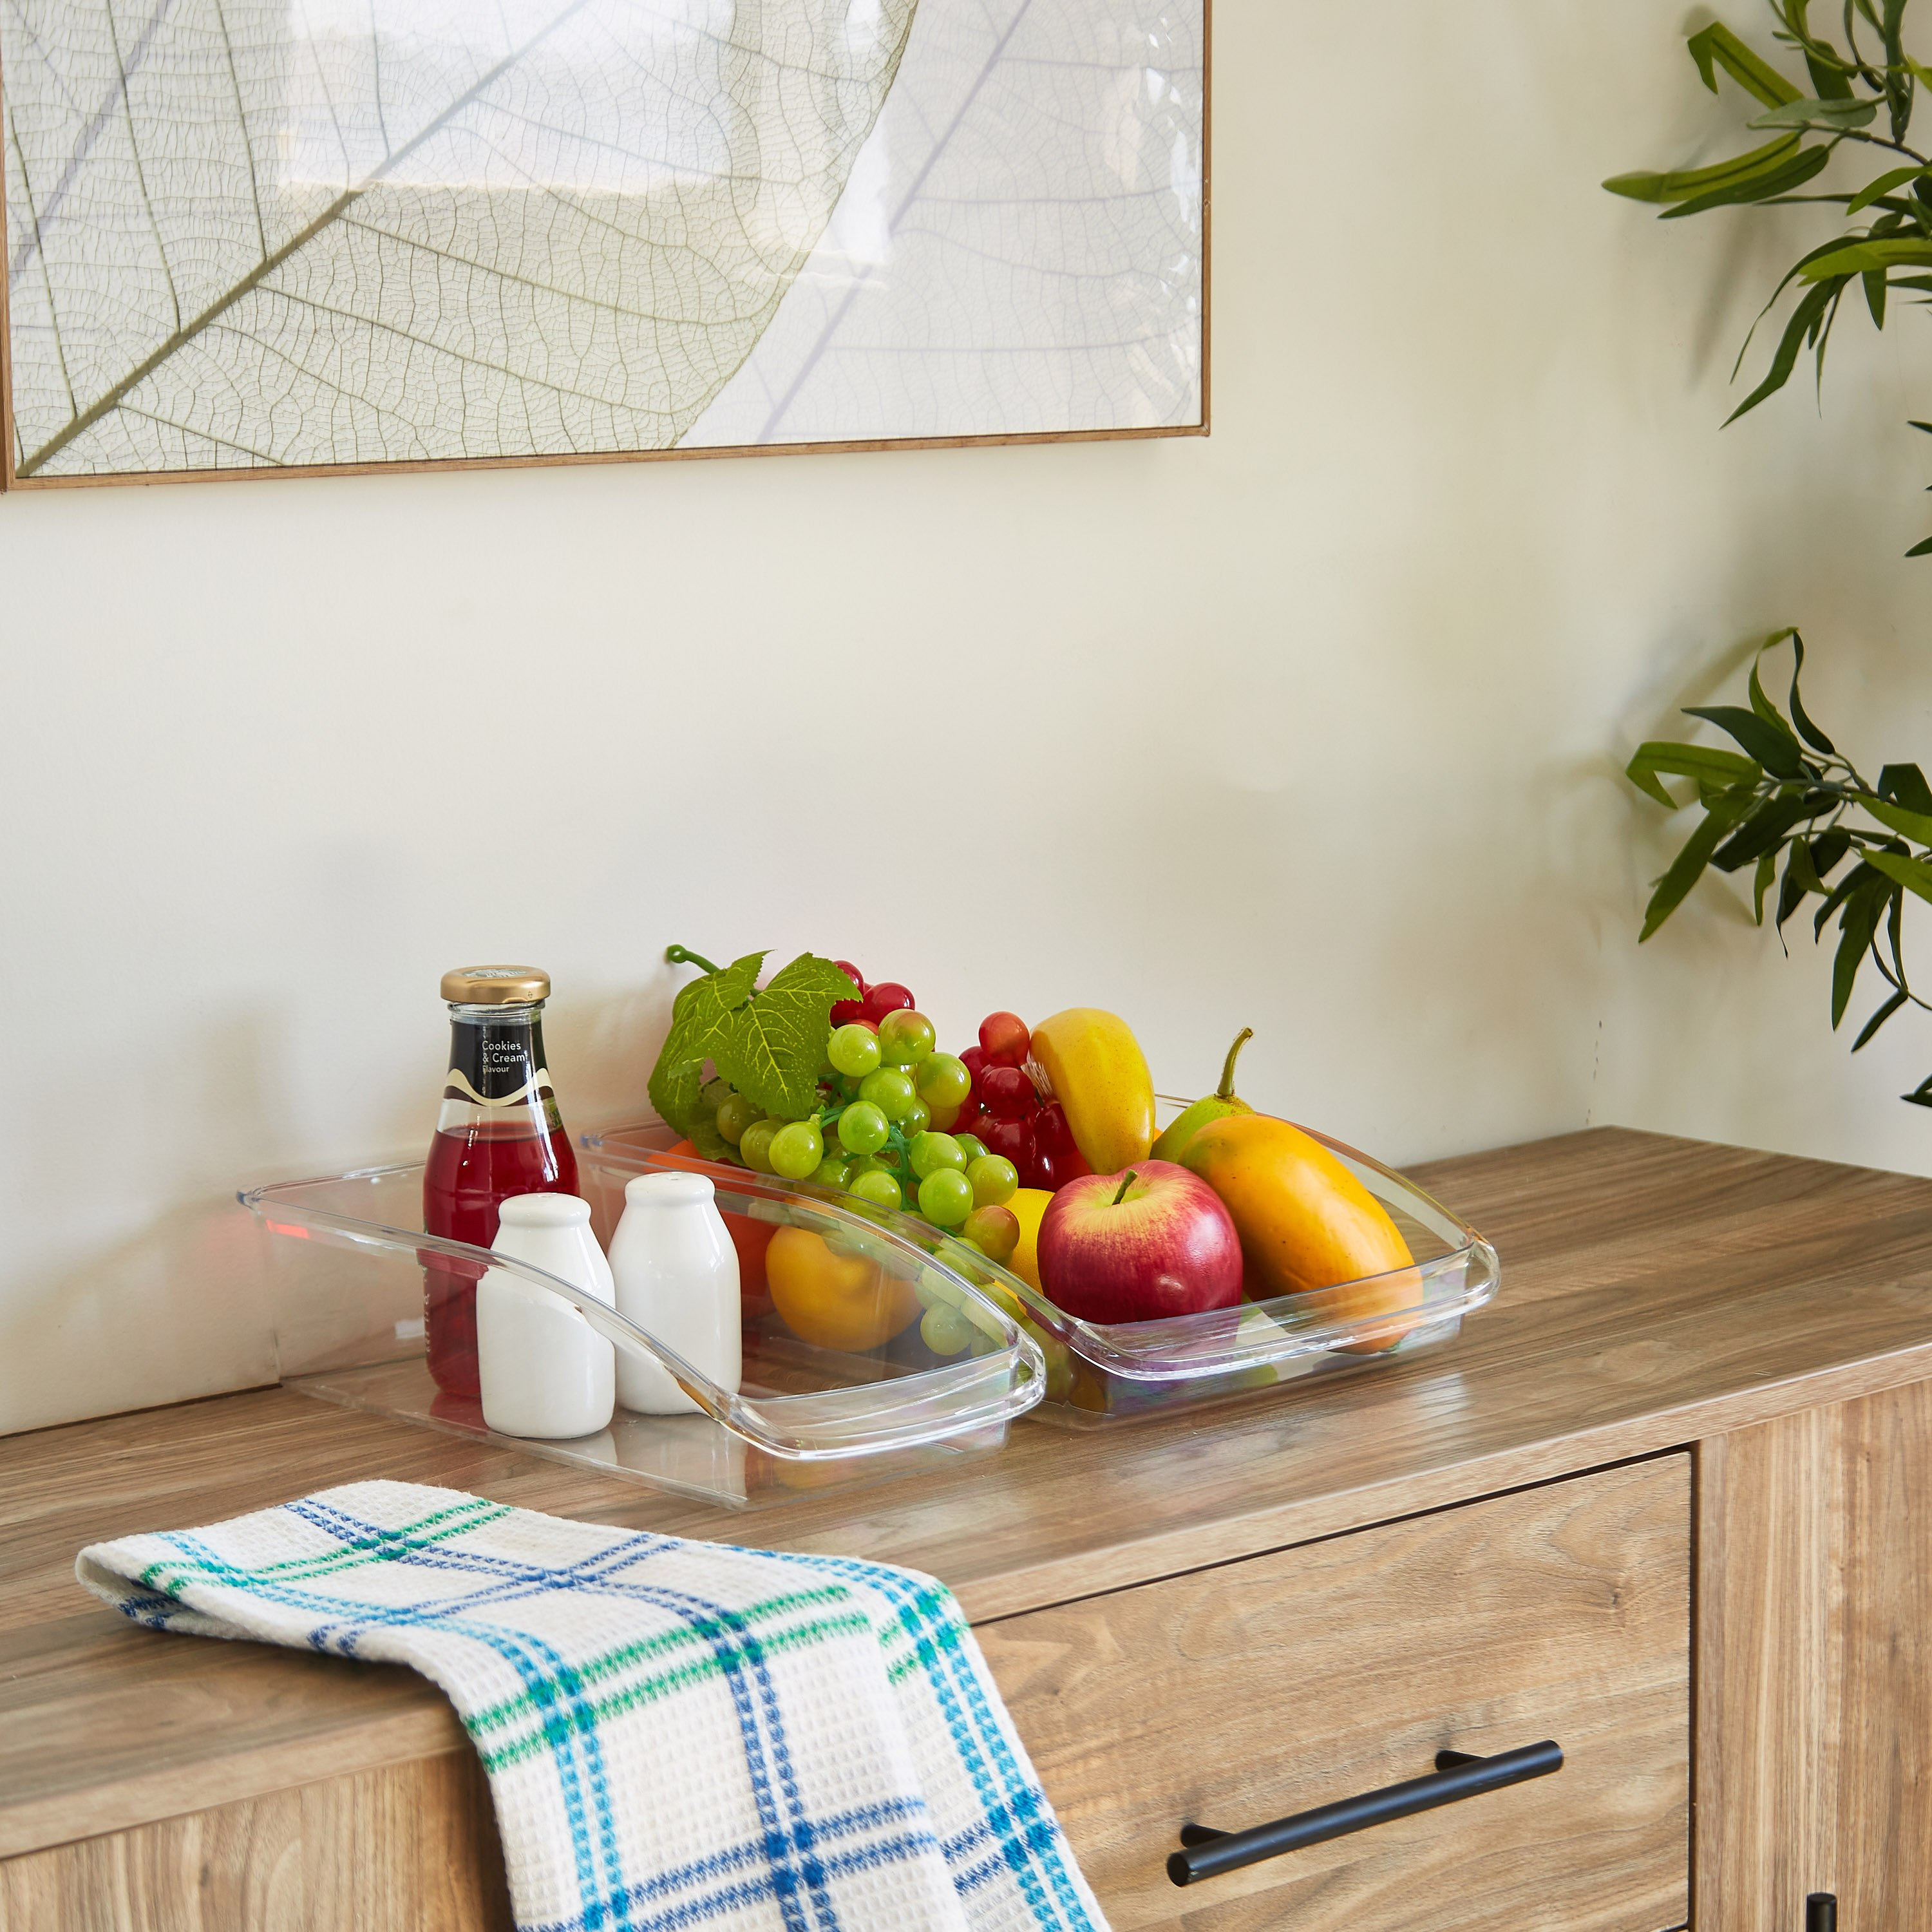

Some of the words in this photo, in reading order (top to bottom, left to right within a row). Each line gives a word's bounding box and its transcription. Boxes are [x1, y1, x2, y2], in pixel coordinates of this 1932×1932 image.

[482, 1040, 521, 1050] Cookies
[482, 1053, 489, 1063] &
[492, 1053, 526, 1063] Cream
